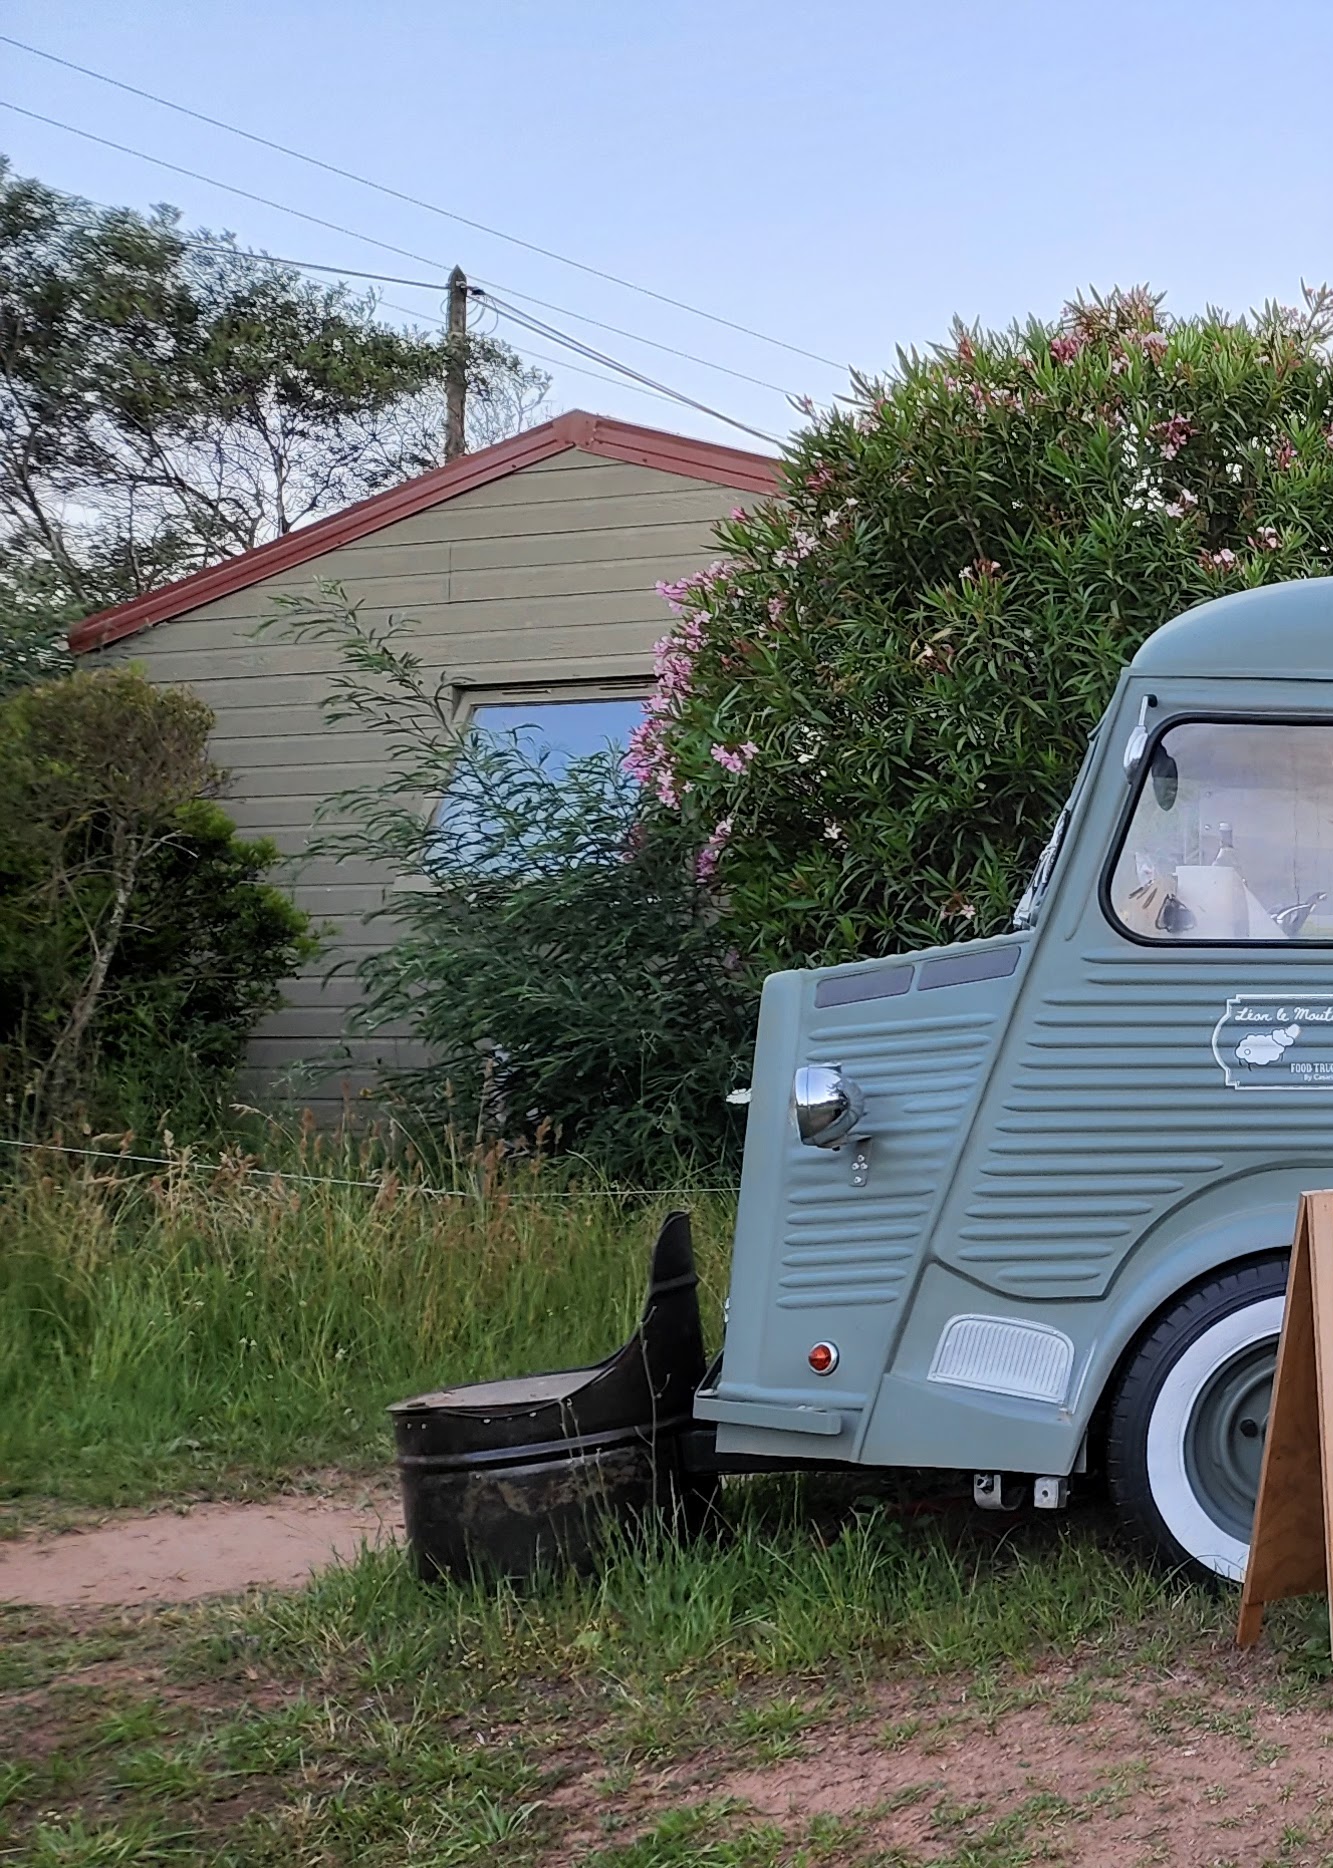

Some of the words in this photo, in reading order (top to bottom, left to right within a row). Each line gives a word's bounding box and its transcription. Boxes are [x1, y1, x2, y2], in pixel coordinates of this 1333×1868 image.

[1234, 1006, 1273, 1021] Léon
[1276, 1007, 1290, 1021] le
[1290, 1063, 1312, 1073] FOOD
[1303, 1074, 1312, 1082] By
